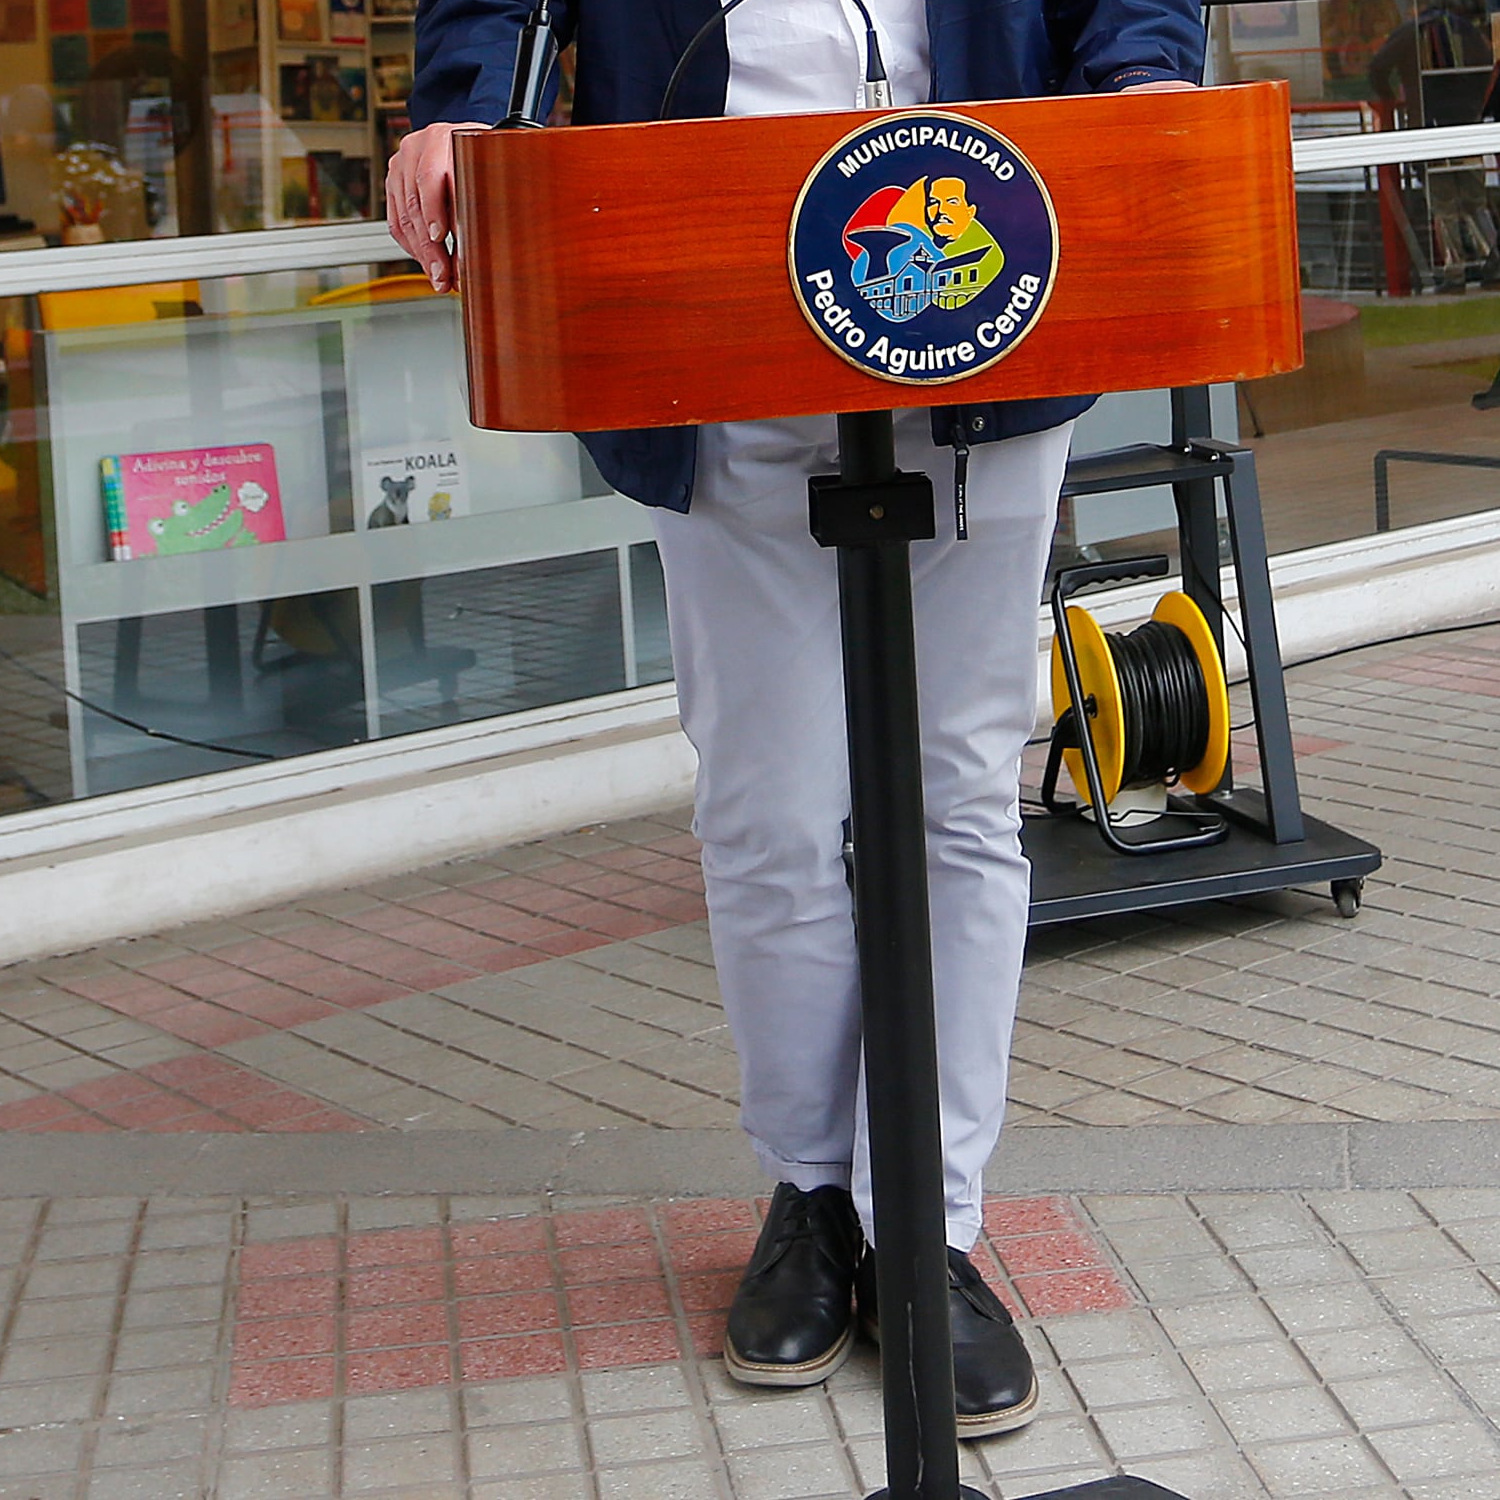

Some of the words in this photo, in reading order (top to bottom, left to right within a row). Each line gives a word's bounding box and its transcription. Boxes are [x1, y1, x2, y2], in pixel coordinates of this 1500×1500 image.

[837, 127, 1015, 181] MUNICIPALIDAD
[806, 269, 866, 347] Pedro
[866, 336, 976, 374] Aguirre
[976, 273, 1041, 349] Cerda
[132, 457, 187, 473] Adivina
[190, 457, 200, 471] y
[203, 449, 263, 467] descubre
[405, 453, 457, 471] KOALA
